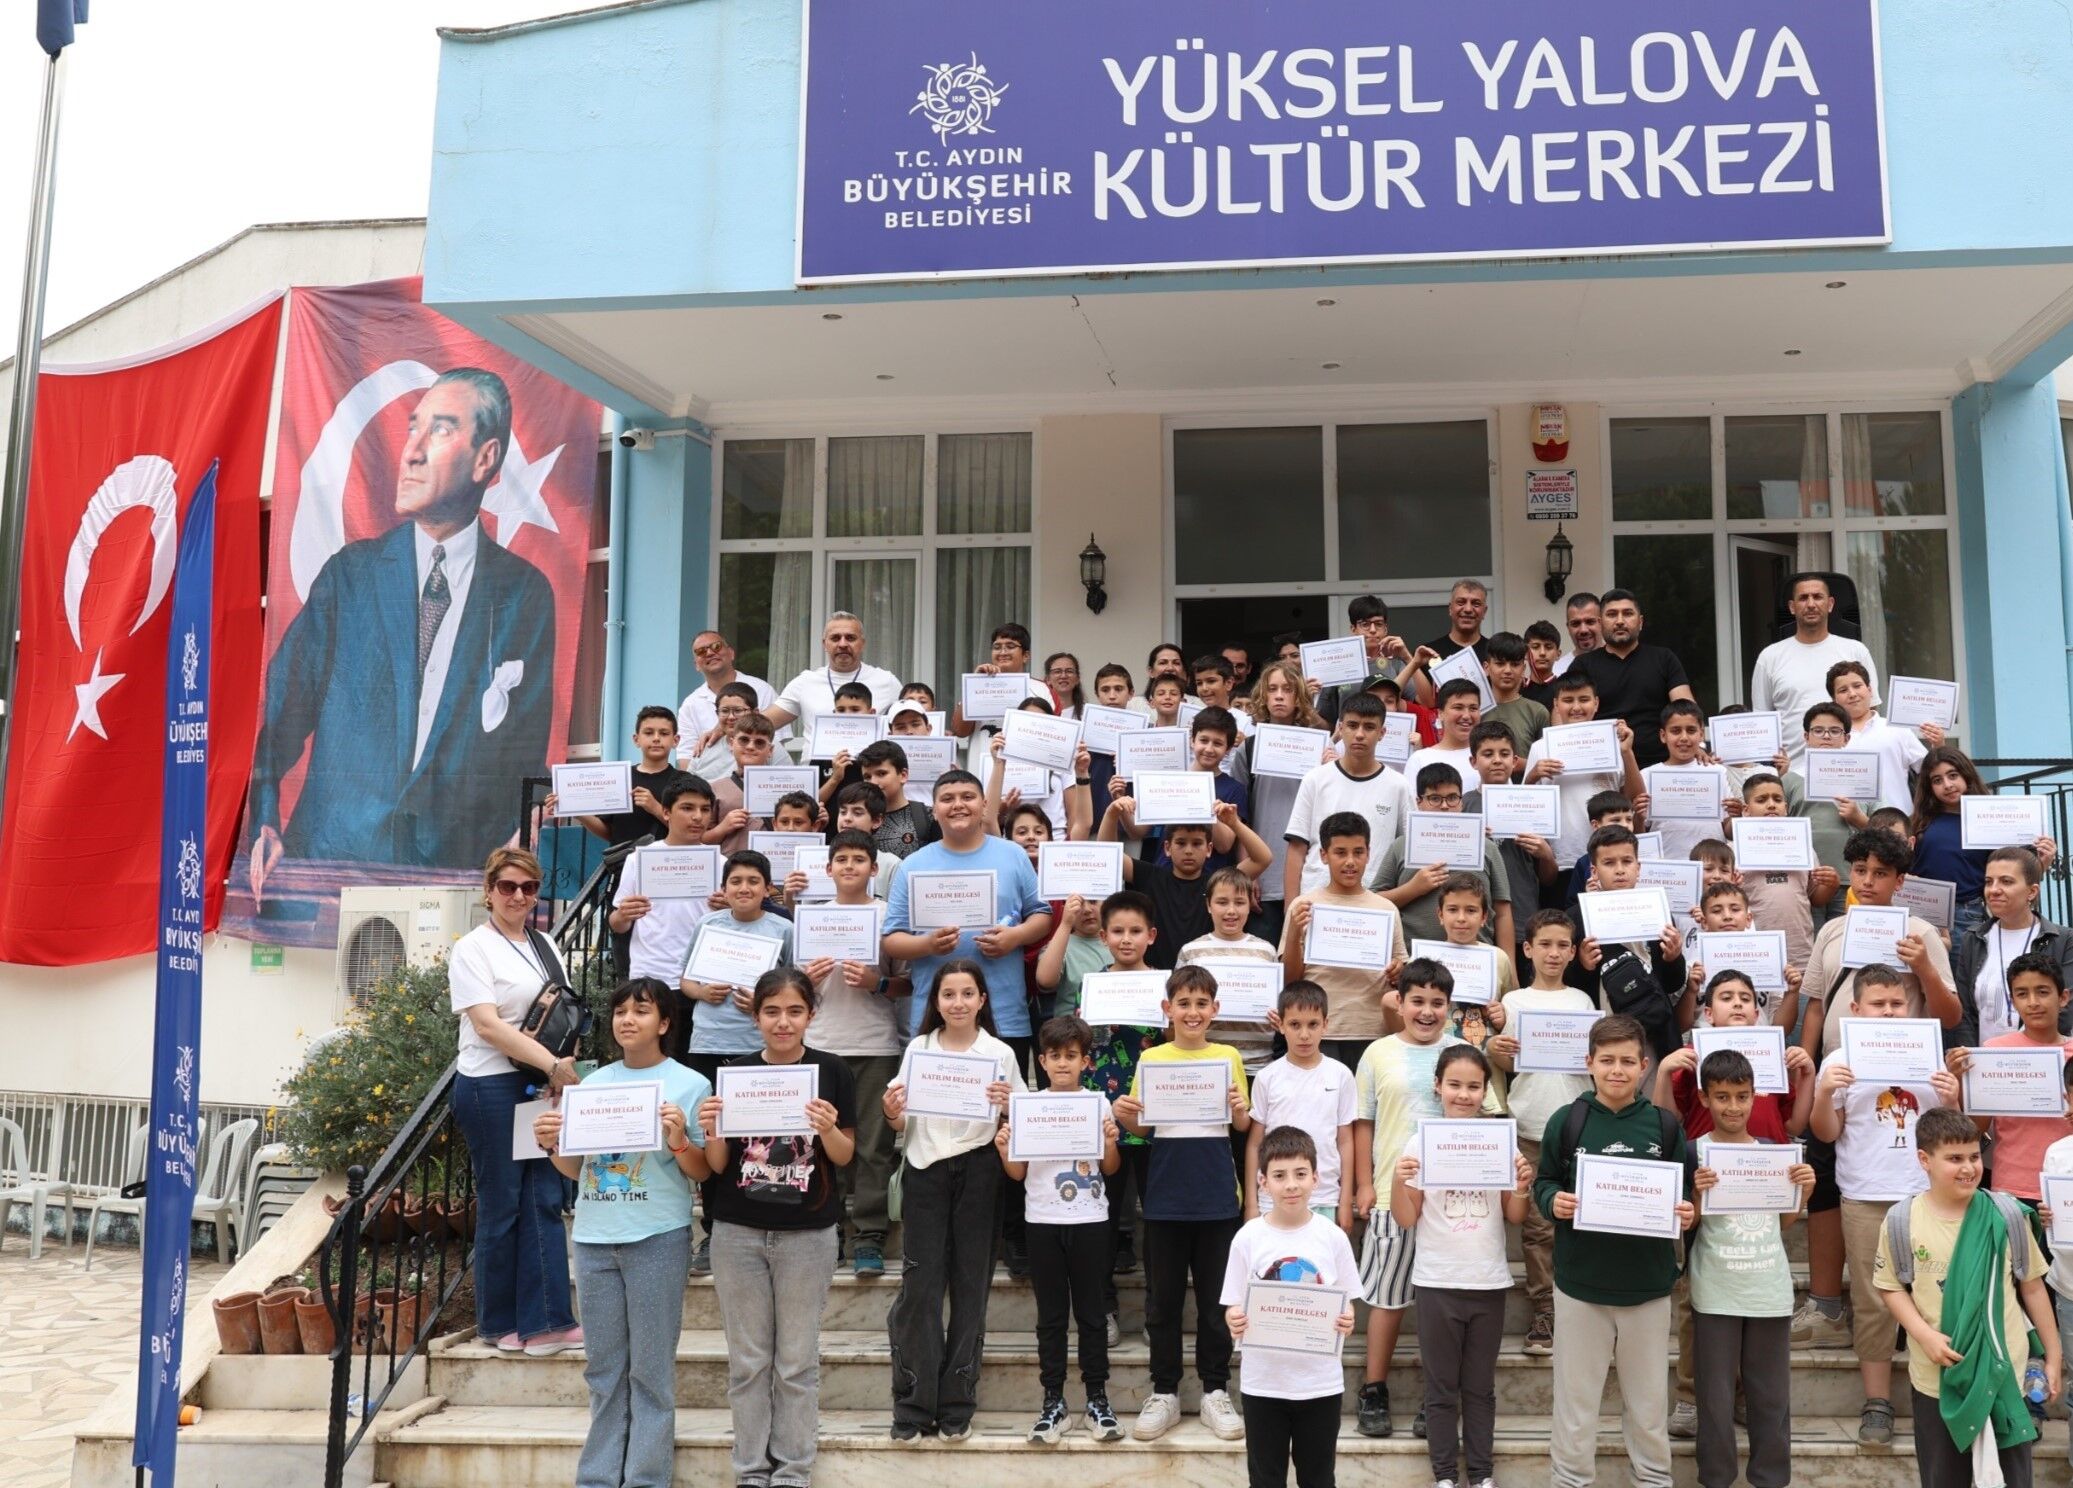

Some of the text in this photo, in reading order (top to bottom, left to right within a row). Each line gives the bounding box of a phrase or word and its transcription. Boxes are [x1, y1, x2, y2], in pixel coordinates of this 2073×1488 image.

[1102, 25, 1820, 126] YÜKSEL YALOVA
[895, 147, 1022, 167] T.C. AYDIN
[1094, 104, 1834, 220] KÜLTÜR MERKEZİ
[844, 167, 1072, 205] BÜYÜKŞEHİR
[885, 203, 1031, 228] BELEDİYESİ
[1531, 494, 1571, 503] AYGES
[1912, 895, 1938, 903] BELGESİ
[921, 1073, 981, 1085] KATILIM BELGESİ
[735, 1090, 766, 1098] KATILIM
[580, 1107, 610, 1115] KATILIM
[1596, 1183, 1661, 1195] KATILIM BELGESİ
[621, 1191, 648, 1201] TIME
[1260, 1305, 1327, 1318] KATILIM BELGESİ
